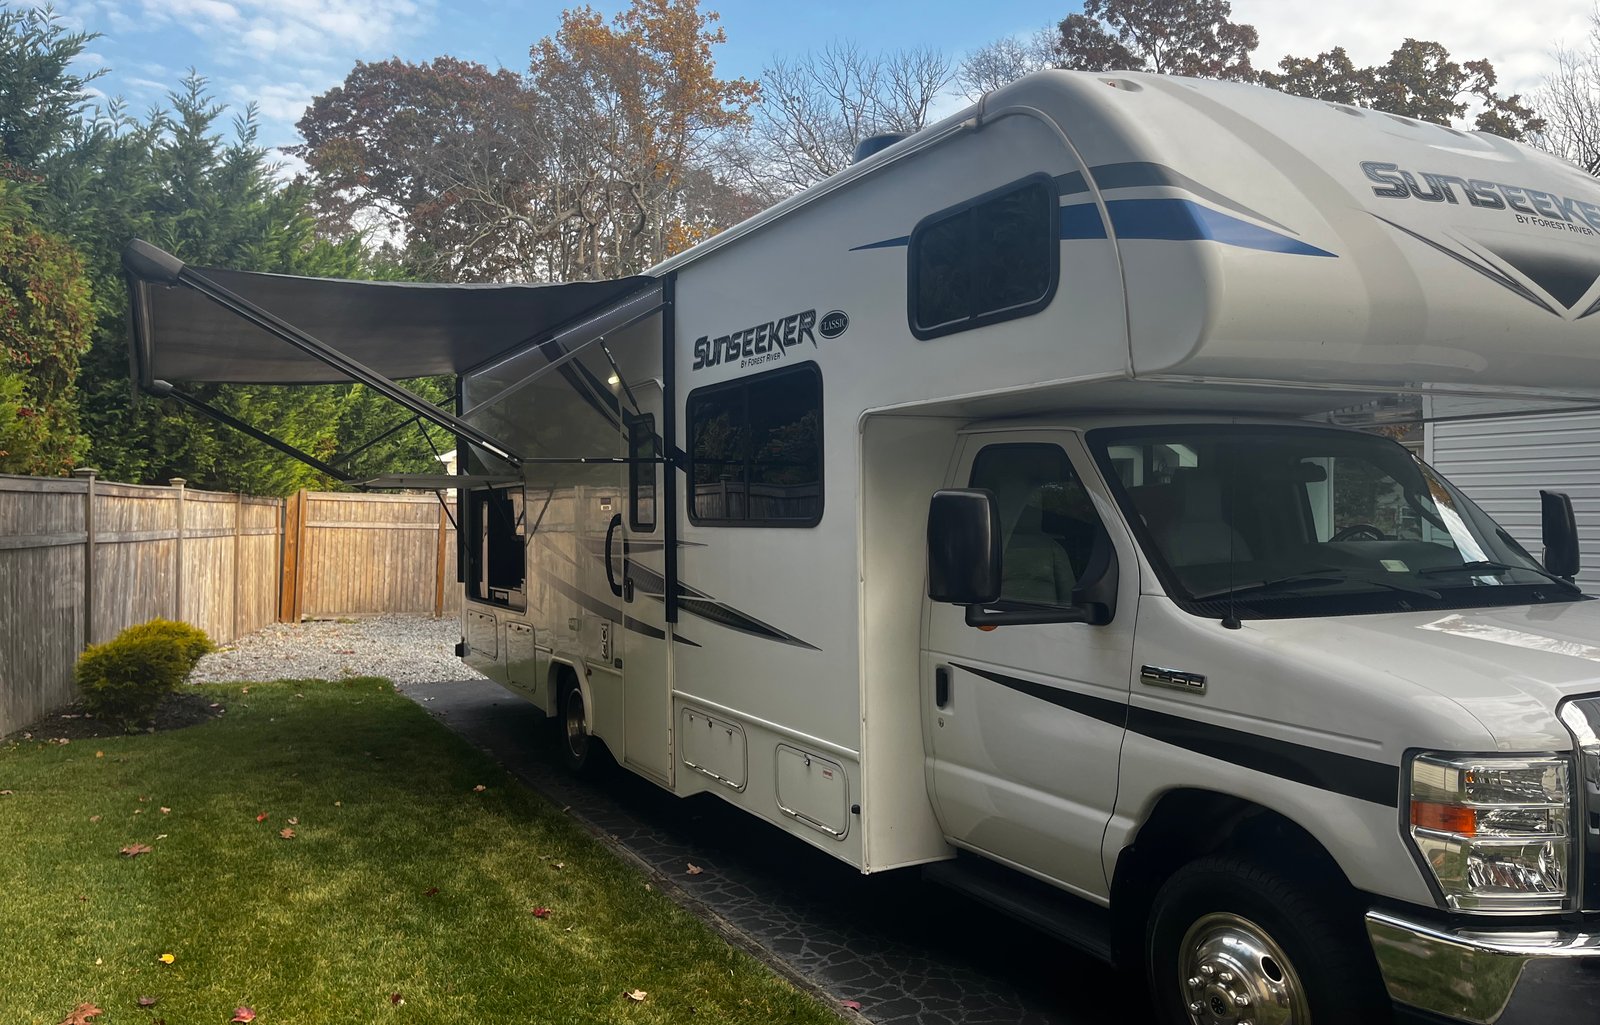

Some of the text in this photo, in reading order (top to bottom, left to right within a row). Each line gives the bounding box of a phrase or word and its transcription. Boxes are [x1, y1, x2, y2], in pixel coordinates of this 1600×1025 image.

[1360, 160, 1600, 235] SUNSEEKE
[1515, 214, 1594, 236] BY FOREST RIVER
[692, 308, 818, 371] SUNSEEKER
[740, 352, 781, 369] BY FOREST RIVER
